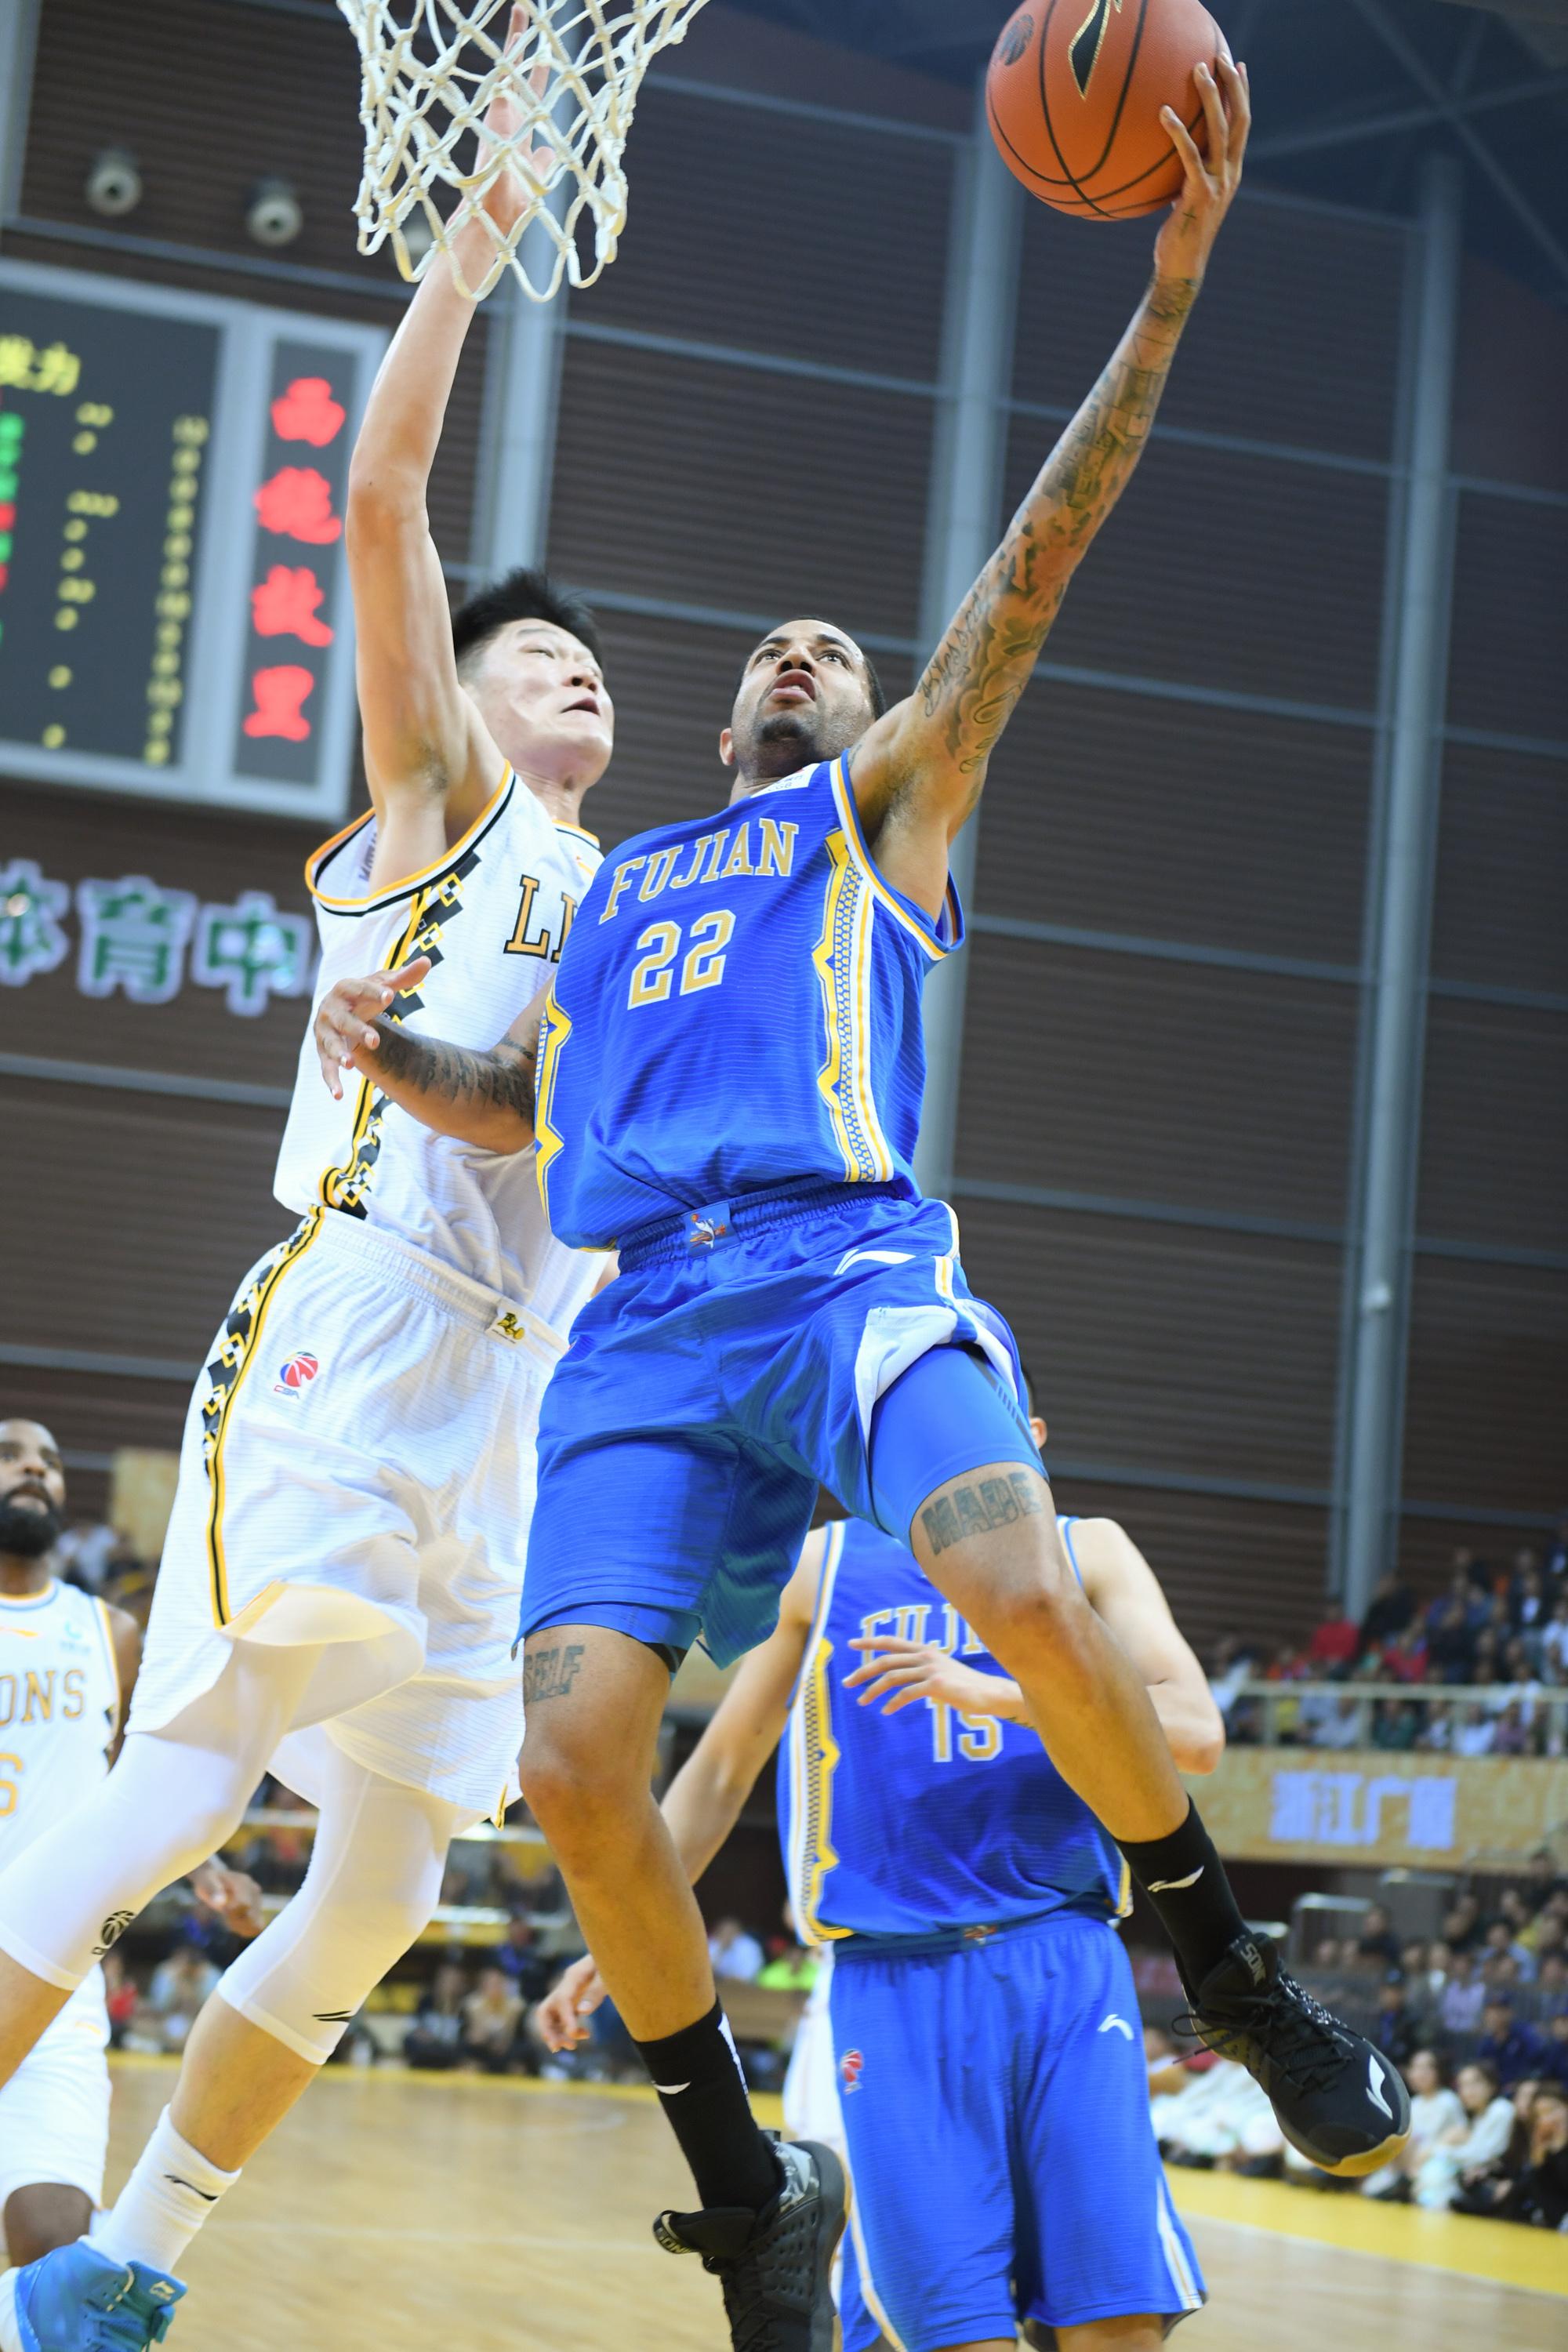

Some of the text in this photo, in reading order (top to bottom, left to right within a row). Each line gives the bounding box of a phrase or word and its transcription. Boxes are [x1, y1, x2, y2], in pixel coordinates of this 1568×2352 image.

[599, 818, 799, 924] FUJIAN
[627, 909, 735, 1011] 22
[926, 1693, 1004, 1762] 15
